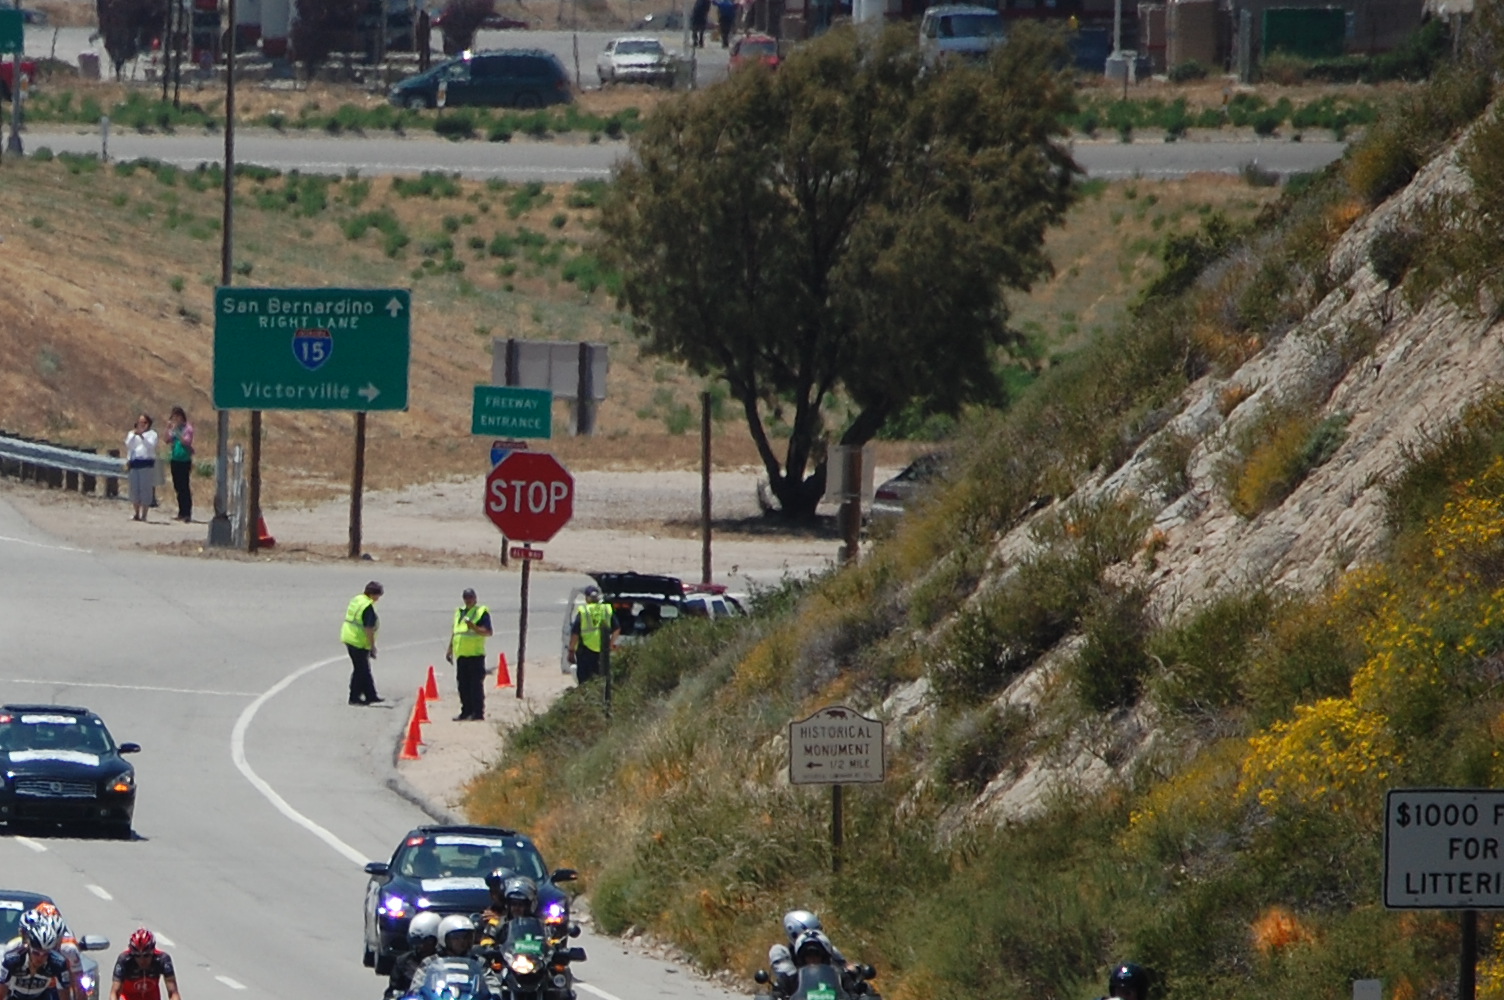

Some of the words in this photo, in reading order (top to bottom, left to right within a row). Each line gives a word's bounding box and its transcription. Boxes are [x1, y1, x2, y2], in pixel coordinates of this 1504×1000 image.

[223, 297, 258, 314] San
[268, 297, 374, 315] Bernardino
[259, 317, 309, 329] RIGHT
[318, 317, 359, 329] LANE
[302, 342, 325, 362] 15
[241, 382, 350, 400] Victorville
[485, 396, 539, 410] FREEWAY
[481, 415, 541, 430] ENTRANCE
[490, 479, 568, 514] STOP
[800, 725, 872, 739] HISTORICAL
[804, 743, 870, 757] MONUMENT
[849, 759, 870, 769] MILE
[1396, 802, 1478, 828] $1000
[1449, 837, 1499, 860] FOR
[1405, 872, 1502, 894] LITTERI
